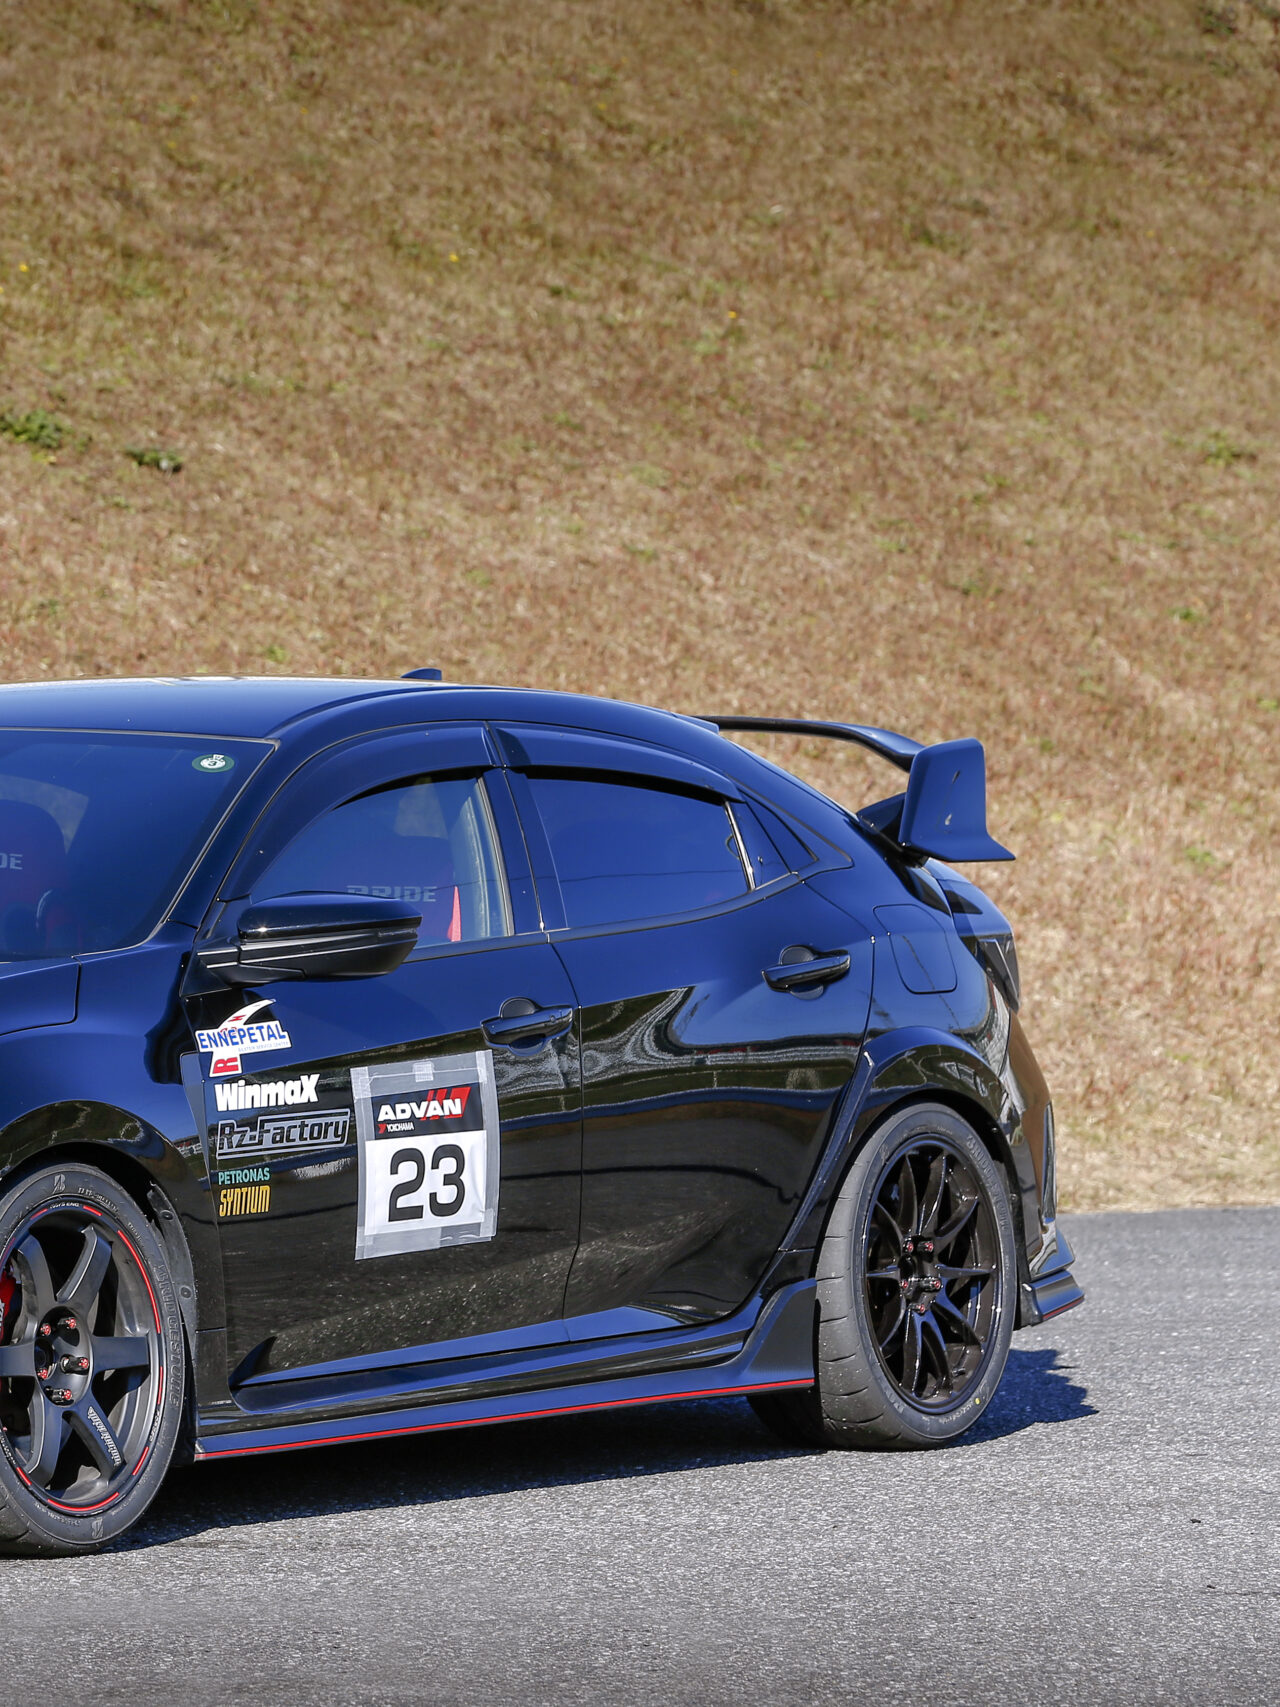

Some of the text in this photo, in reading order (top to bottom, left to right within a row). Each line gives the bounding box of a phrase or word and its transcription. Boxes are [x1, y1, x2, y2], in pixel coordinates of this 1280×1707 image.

[197, 1023, 287, 1049] ENNEPETAL
[377, 1097, 463, 1122] ADVAN
[386, 1121, 415, 1133] YOKOHAMA
[218, 1167, 271, 1186] PETRONAS
[388, 1143, 466, 1223] 23
[218, 1184, 271, 1217] SYNTIUM
[152, 1264, 181, 1407] BRIDGESTONE
